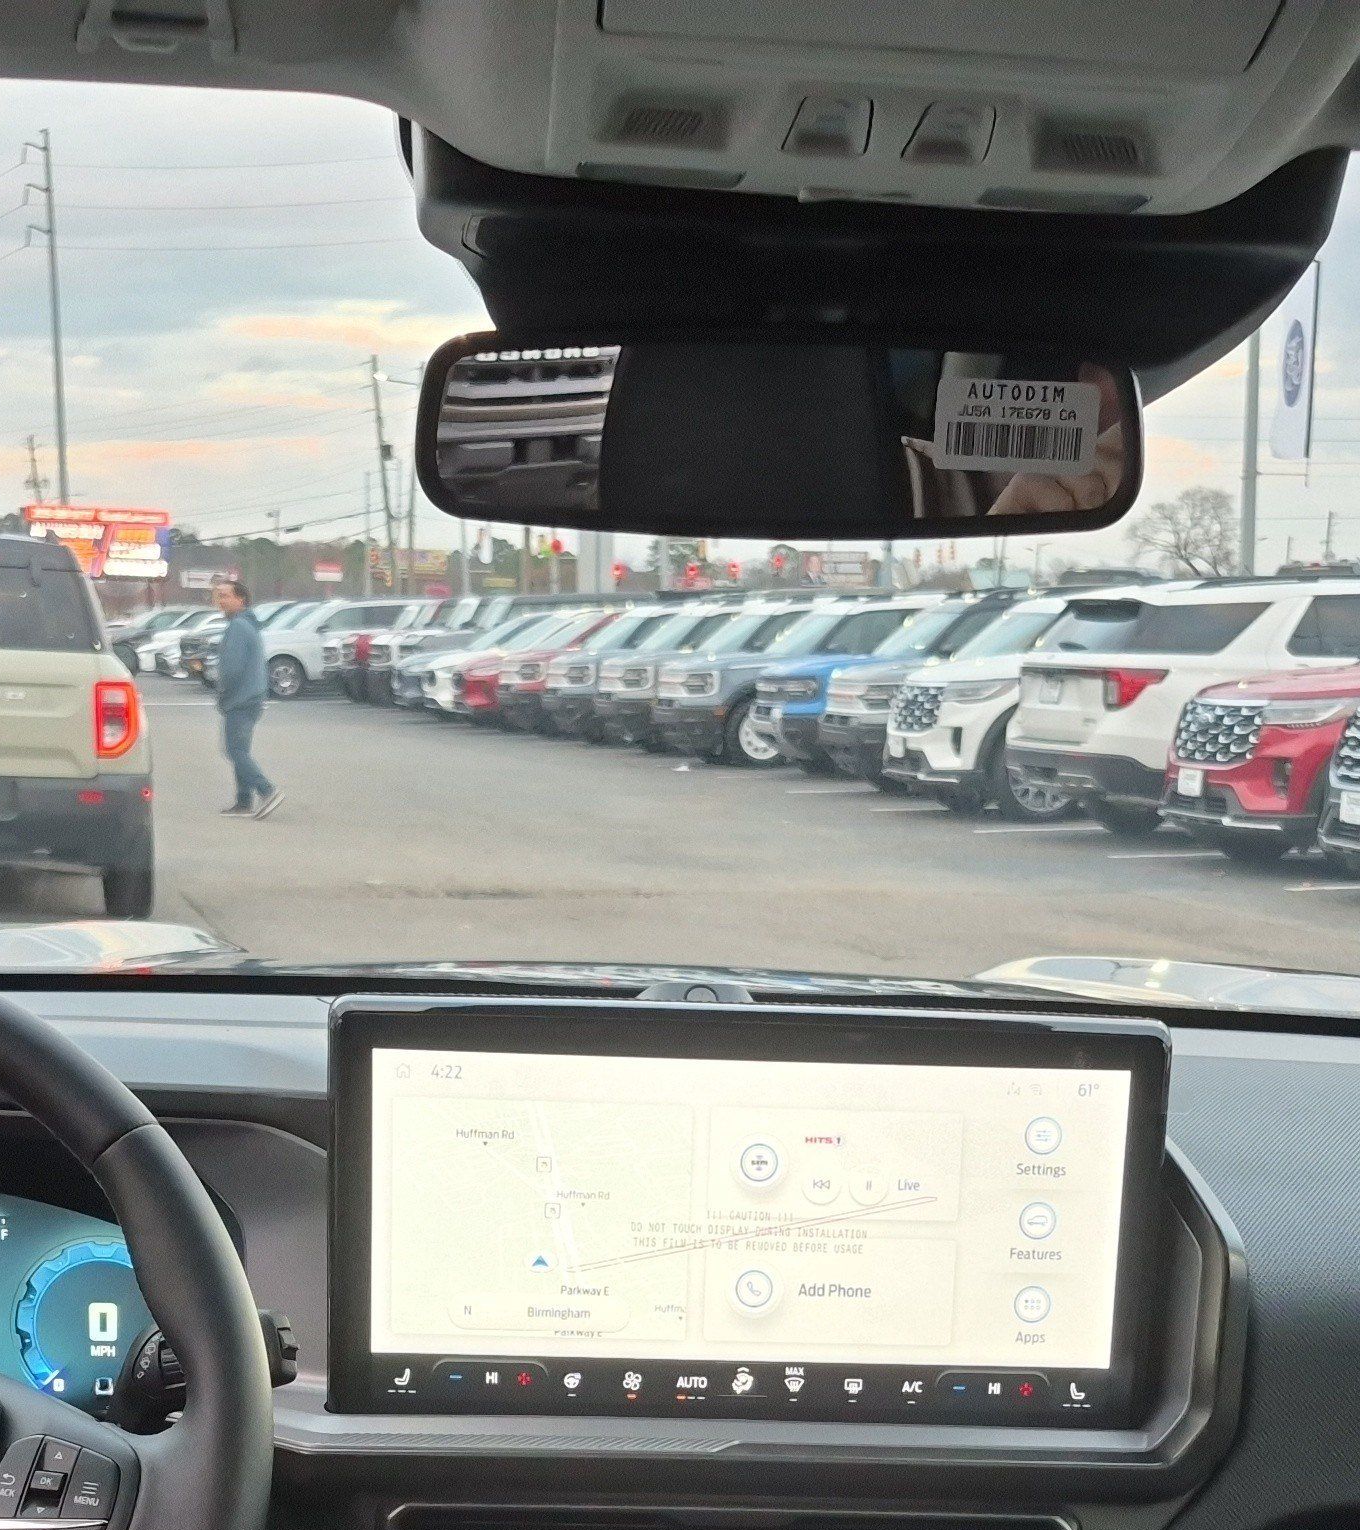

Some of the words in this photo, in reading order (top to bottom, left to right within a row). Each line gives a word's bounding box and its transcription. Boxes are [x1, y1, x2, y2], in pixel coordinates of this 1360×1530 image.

[968, 383, 1065, 403] AUTODIM
[431, 1065, 462, 1079] 4:22
[456, 1129, 499, 1140] Huffman
[502, 1130, 515, 1140] Rd
[805, 1136, 833, 1144] HITS
[1017, 1163, 1066, 1177] Settings
[898, 1179, 920, 1191] Live
[557, 1190, 596, 1200] Huffman
[599, 1191, 610, 1200] Rd
[730, 1211, 771, 1222] CAUTION
[0, 1229, 8, 1240] F
[649, 1223, 666, 1232] NOT
[673, 1223, 702, 1234] TOUCH
[708, 1225, 748, 1236] DISPLAY
[797, 1227, 868, 1239] INSTALLATION
[634, 1237, 657, 1247] THIS
[711, 1239, 722, 1249] TO
[746, 1241, 787, 1252] REMOVED
[834, 1244, 863, 1254] USAGE
[1010, 1248, 1062, 1261] Features
[560, 1286, 602, 1297] Parkway
[798, 1284, 825, 1297] Add
[828, 1285, 872, 1298] Phone
[464, 1305, 472, 1315] N
[527, 1307, 591, 1320] Birmingham
[89, 1303, 118, 1341] 0
[1015, 1331, 1046, 1343] Apps
[91, 1346, 115, 1357] MPH
[485, 1371, 498, 1384] HI
[784, 1367, 804, 1376] MAX
[676, 1375, 707, 1389] AUTO
[902, 1382, 923, 1394] A/C
[988, 1382, 1001, 1395] HI
[40, 1477, 52, 1486] OK
[73, 1496, 100, 1507] MENU
